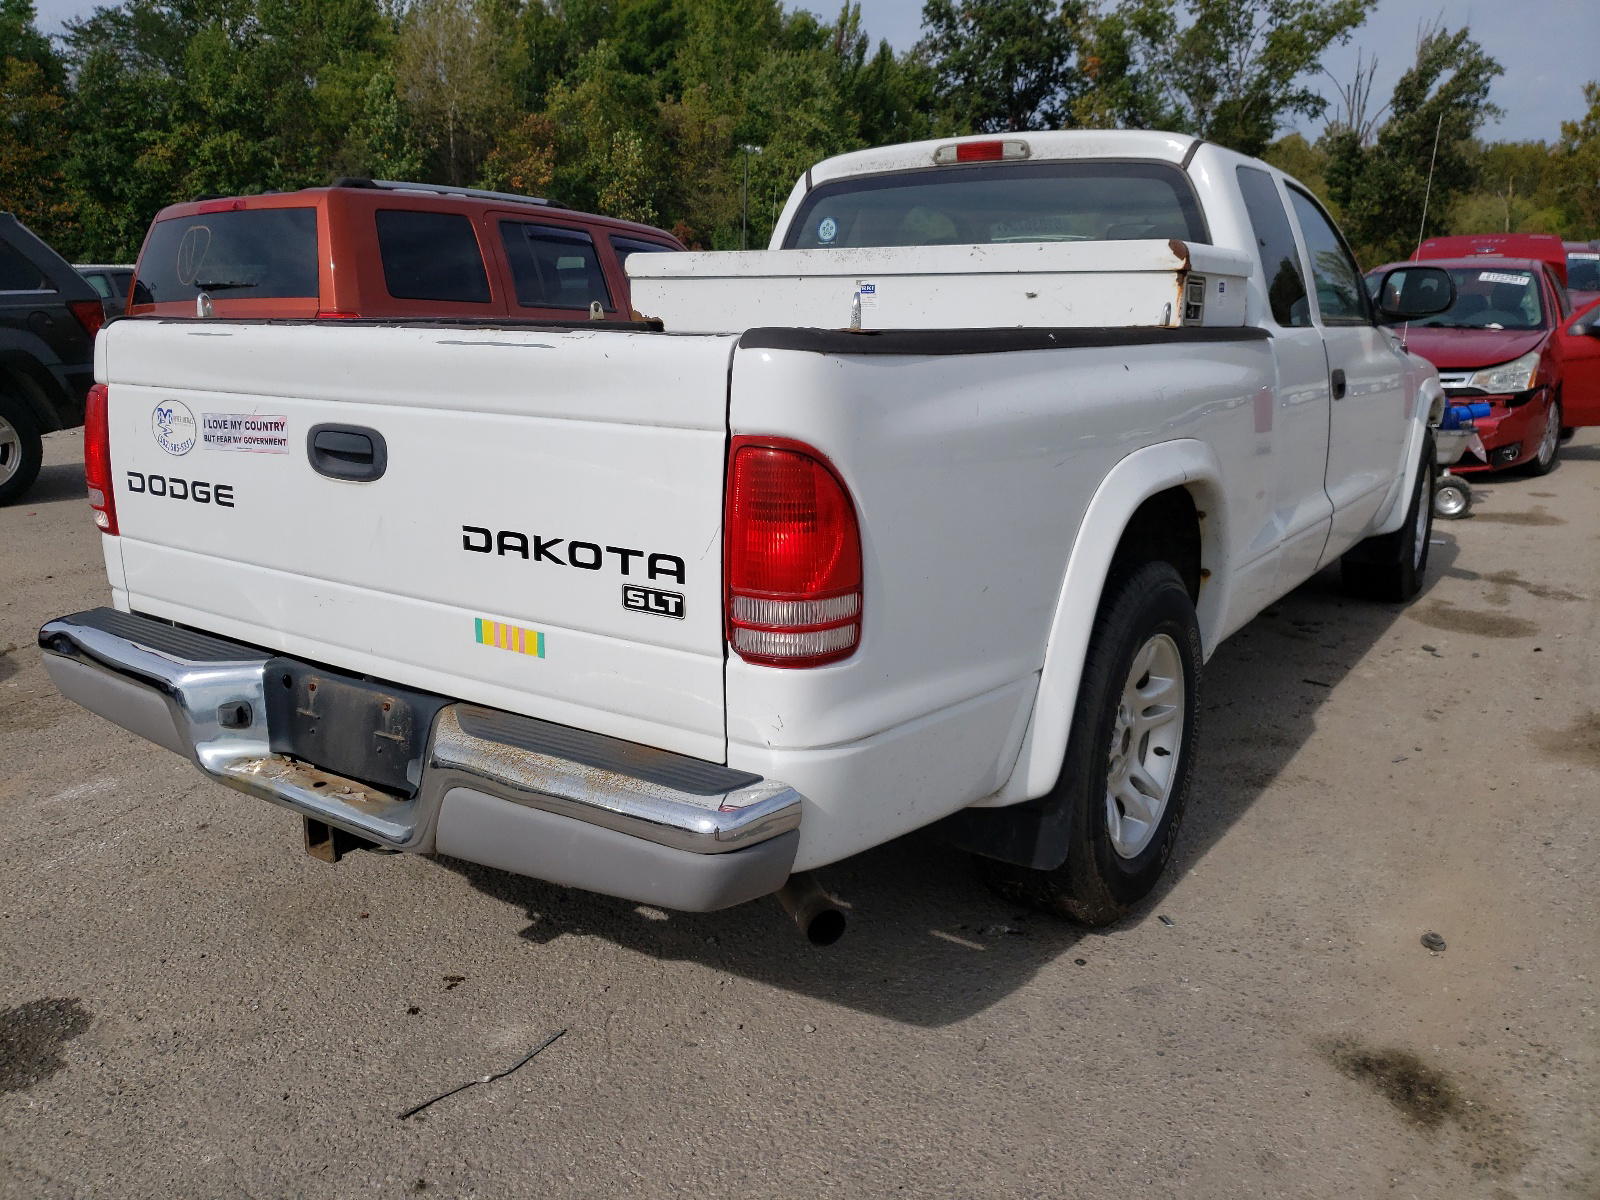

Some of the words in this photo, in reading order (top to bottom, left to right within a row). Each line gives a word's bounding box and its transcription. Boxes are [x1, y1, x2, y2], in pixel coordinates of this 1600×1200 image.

[208, 419, 228, 429] LOVE
[231, 420, 242, 430] MY
[244, 420, 285, 432] COUNTRY
[203, 434, 215, 443] BUT
[216, 435, 232, 443] FEAR
[243, 436, 287, 446] GOVERNMENT
[127, 471, 234, 508] DODGE
[462, 525, 685, 584] DAKOTA
[626, 589, 681, 613] SLT
